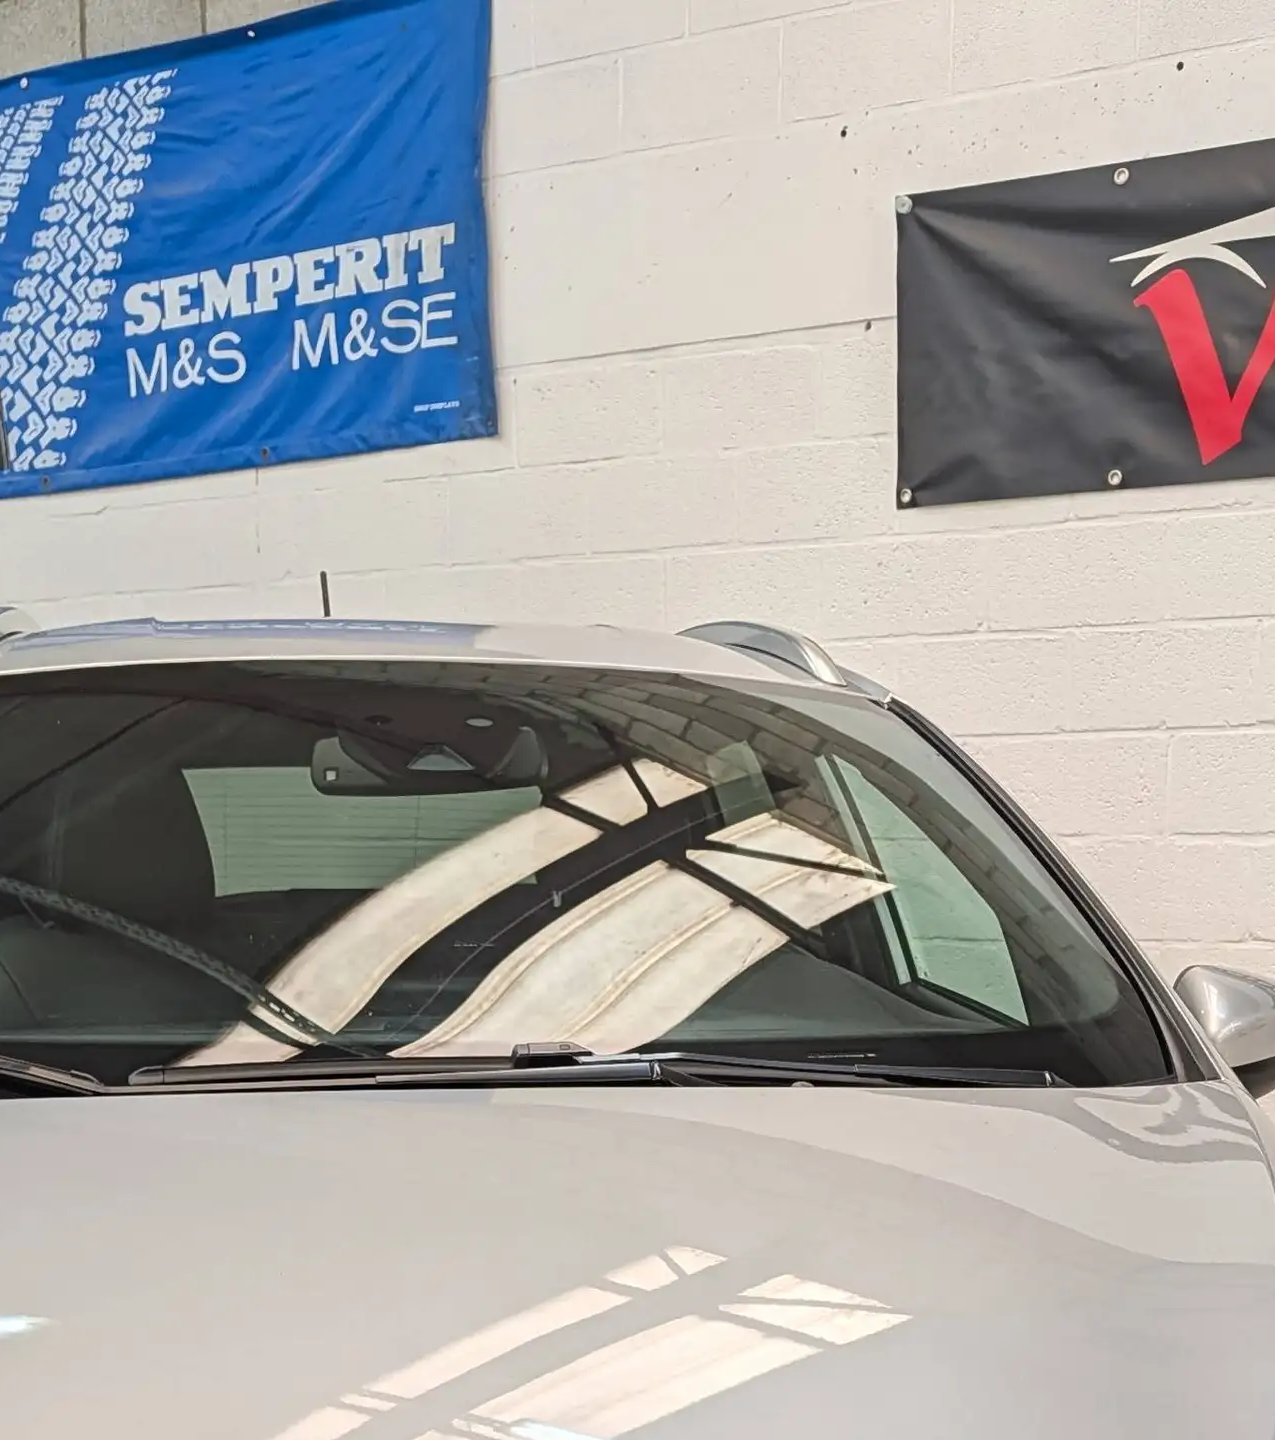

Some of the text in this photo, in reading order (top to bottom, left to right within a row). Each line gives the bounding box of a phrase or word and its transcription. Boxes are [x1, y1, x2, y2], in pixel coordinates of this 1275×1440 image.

[123, 222, 456, 337] SEMPERIT
[126, 292, 459, 398] M&S M&SE
